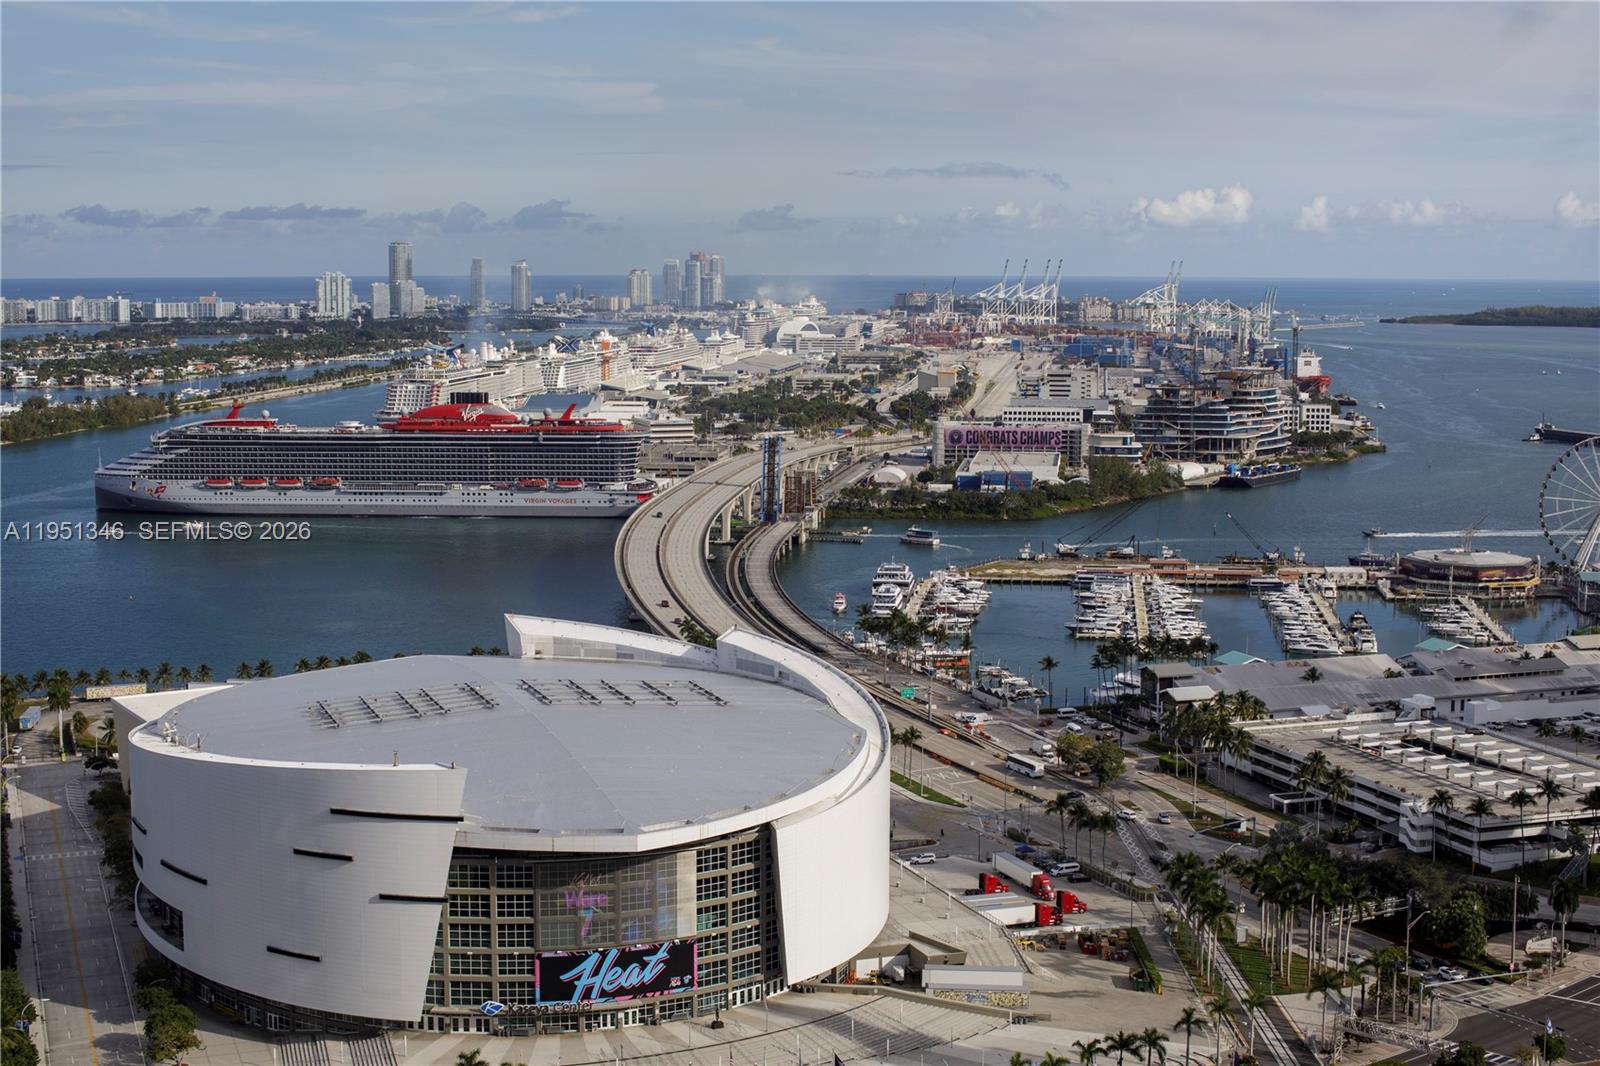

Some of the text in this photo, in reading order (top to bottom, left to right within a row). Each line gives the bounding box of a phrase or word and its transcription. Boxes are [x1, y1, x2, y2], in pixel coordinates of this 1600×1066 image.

[461, 403, 485, 423] Virgin
[966, 430, 1062, 445] CONGRATS CHAMPS
[559, 941, 673, 1003] Heat
[507, 1000, 594, 1015] Kaseya Center
